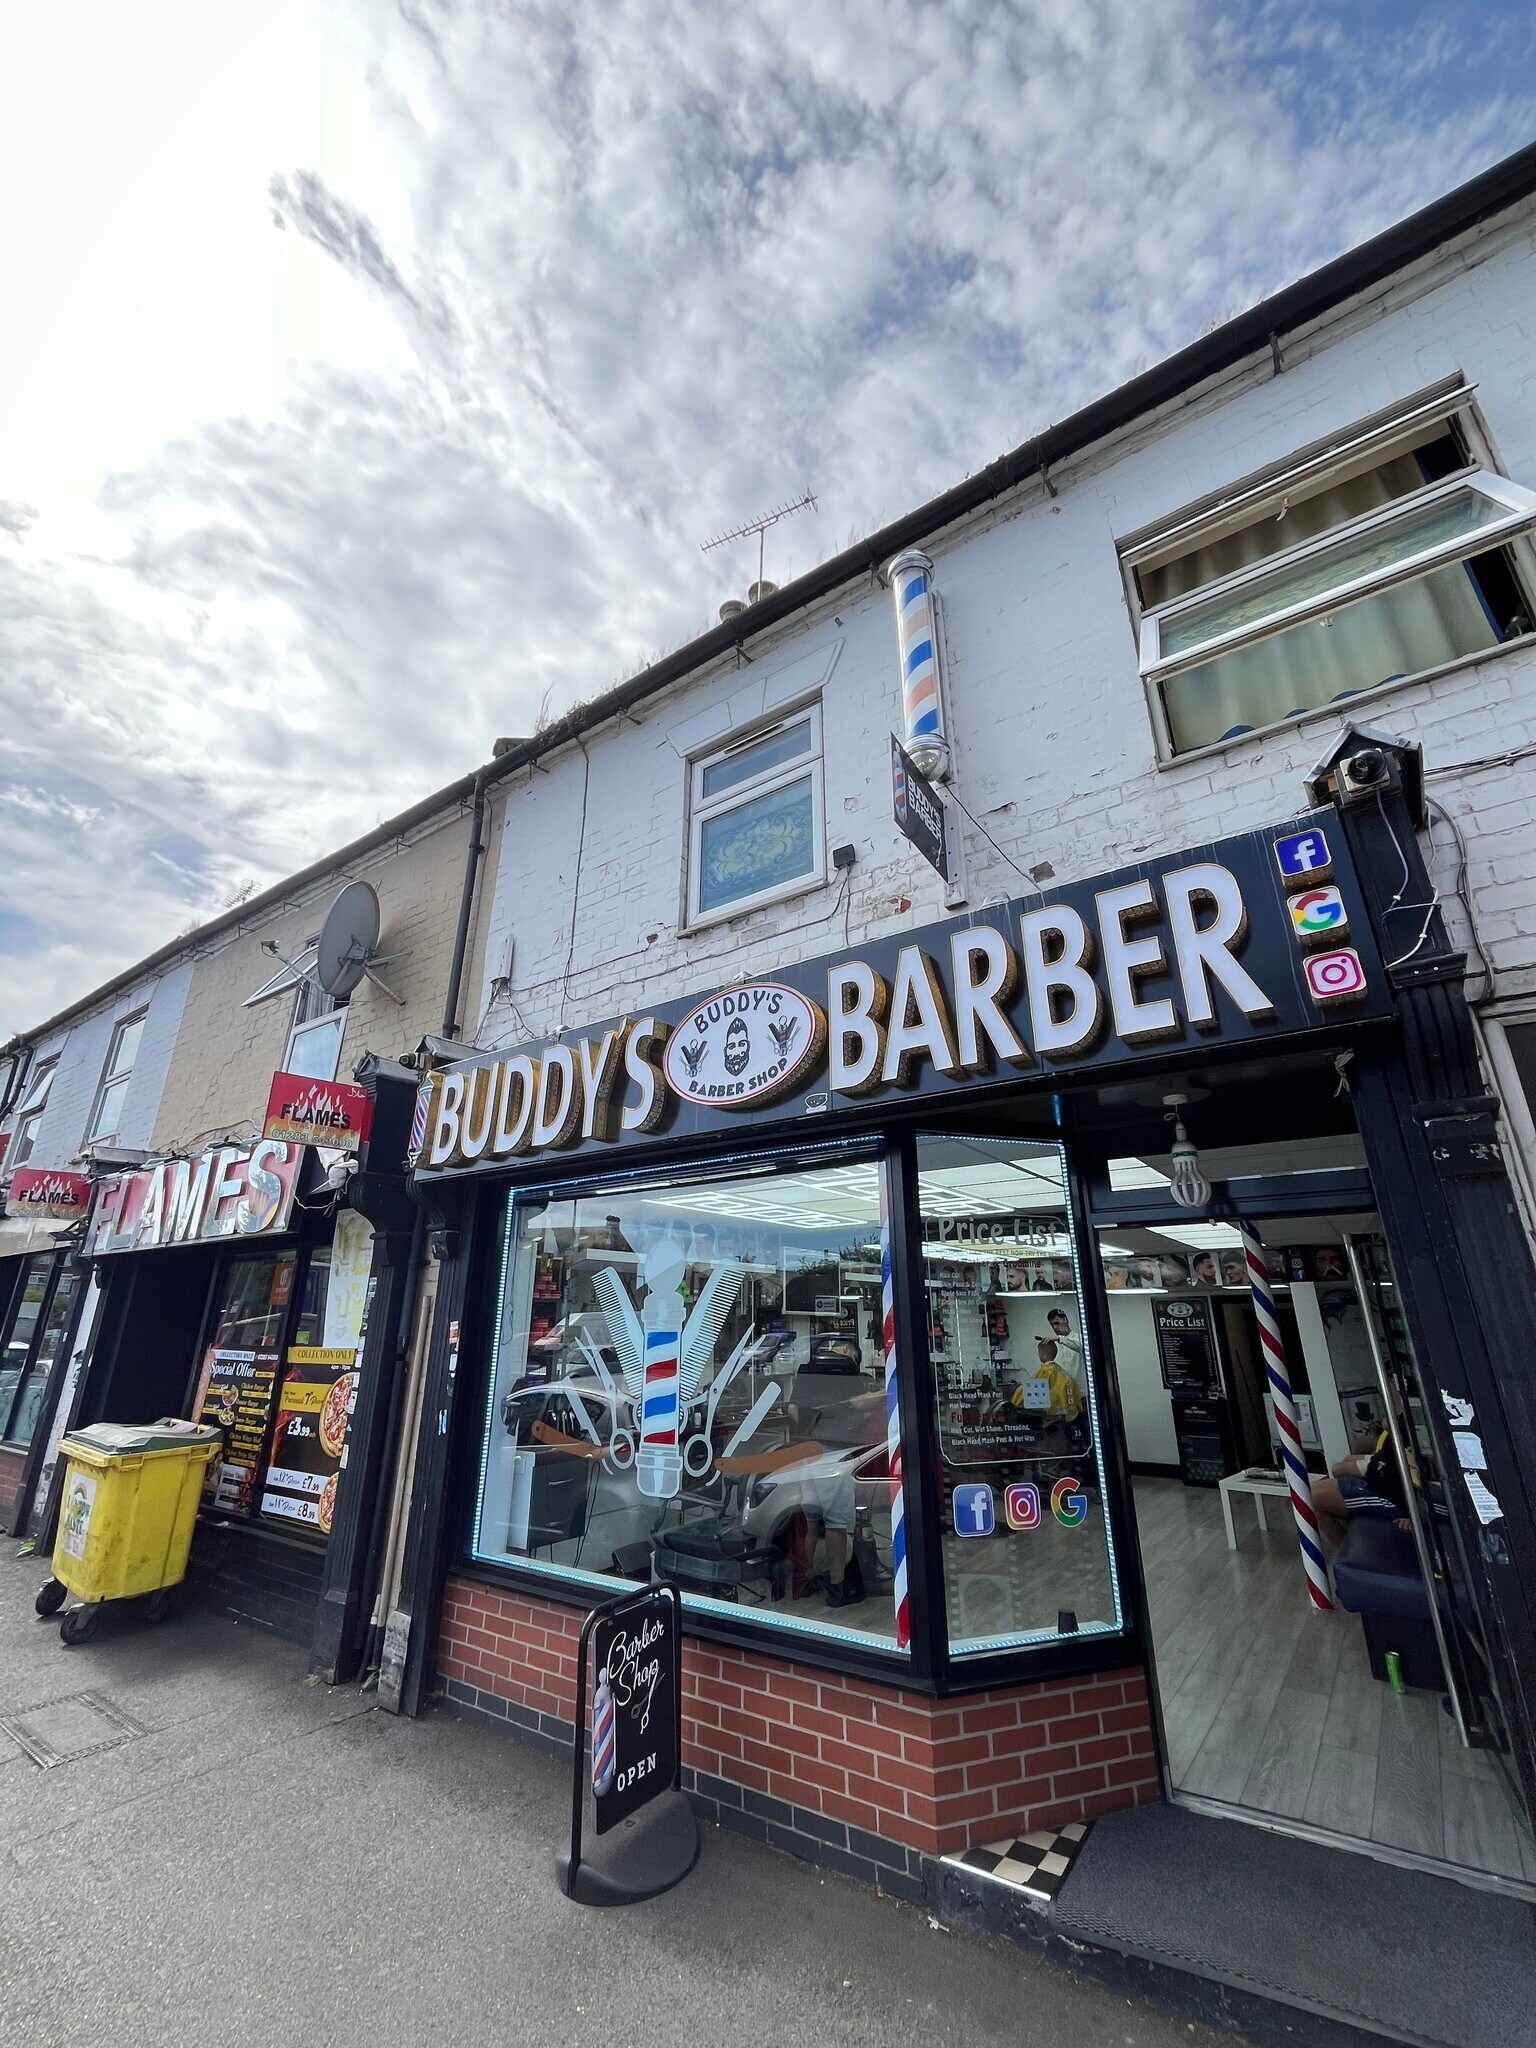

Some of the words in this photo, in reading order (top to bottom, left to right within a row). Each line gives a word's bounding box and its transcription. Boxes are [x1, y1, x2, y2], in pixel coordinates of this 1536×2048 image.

[908, 775, 941, 828] BUDDY'S
[909, 791, 942, 840] BARBER
[828, 863, 1275, 1091] BARBER
[694, 990, 783, 1034] BUDDY'S
[347, 1088, 366, 1098] حلال
[430, 1016, 656, 1165] BUDDY'S
[689, 1080, 745, 1098] BARBER
[749, 1057, 788, 1091] SHOP
[281, 1104, 351, 1130] FLAMES
[19, 1189, 80, 1206] FLAMES
[84, 1140, 288, 1251] FLAMES
[938, 1217, 1004, 1246] Price
[1014, 1218, 1057, 1247] List
[1160, 1318, 1184, 1327] Price
[1187, 1318, 1205, 1327] List
[210, 1361, 235, 1379] Special
[236, 1362, 257, 1377] Offer
[297, 1349, 334, 1359] COLLECTION
[335, 1350, 352, 1359] ONLY
[287, 1417, 310, 1437] £3.99
[301, 1475, 320, 1492] £7.99
[297, 1502, 315, 1519] £8.99
[607, 1617, 664, 1680] Barber
[615, 1657, 660, 1707] Shop
[616, 1752, 657, 1793] OPEN
